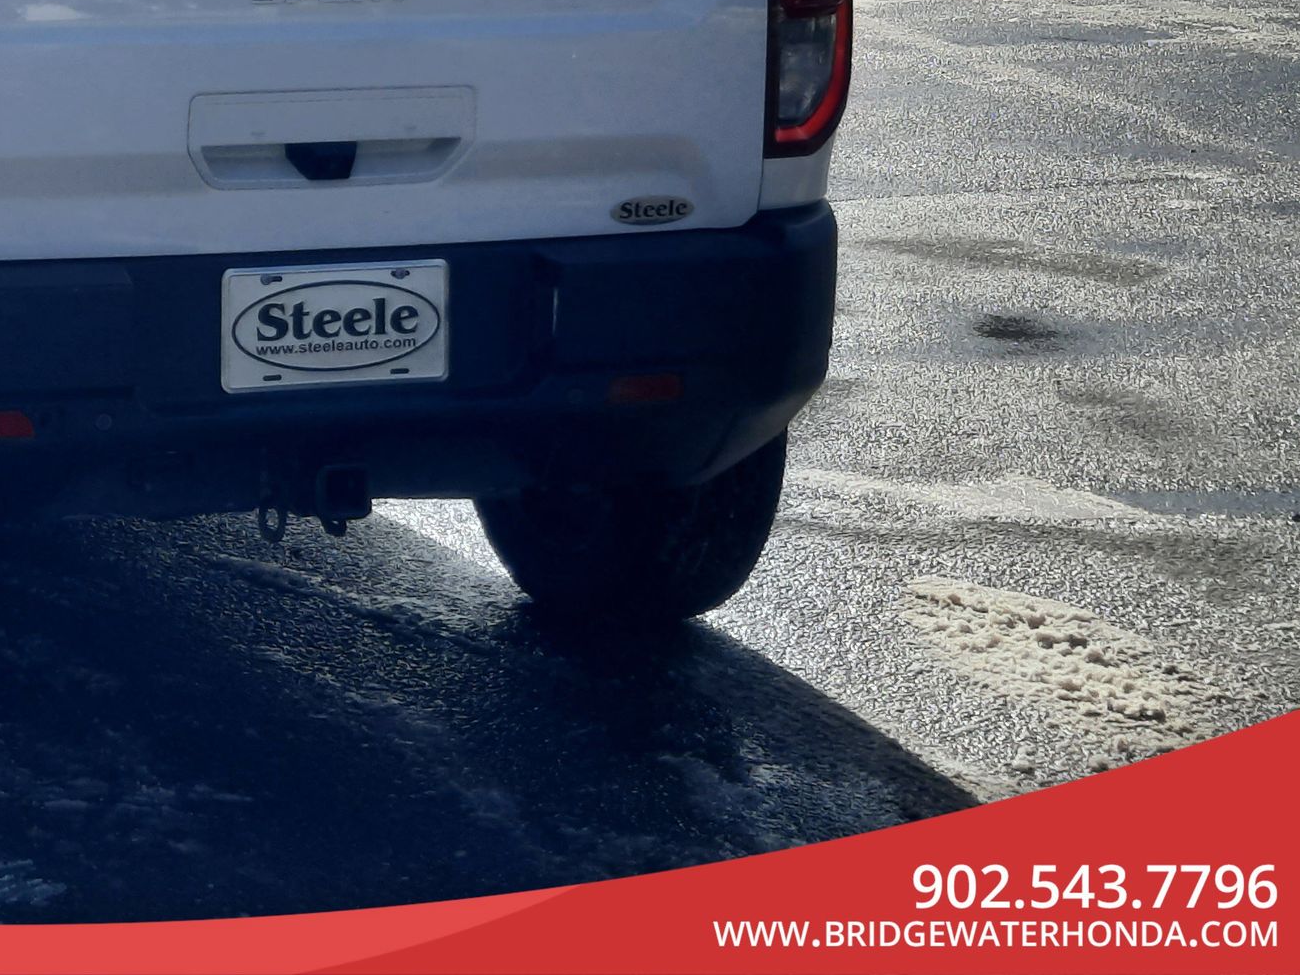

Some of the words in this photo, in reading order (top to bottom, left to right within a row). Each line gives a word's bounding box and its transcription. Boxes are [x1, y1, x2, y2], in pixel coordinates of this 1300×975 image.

[619, 199, 688, 219] Steele
[256, 297, 419, 342] Steele
[256, 337, 417, 356] www.steeleauto.com
